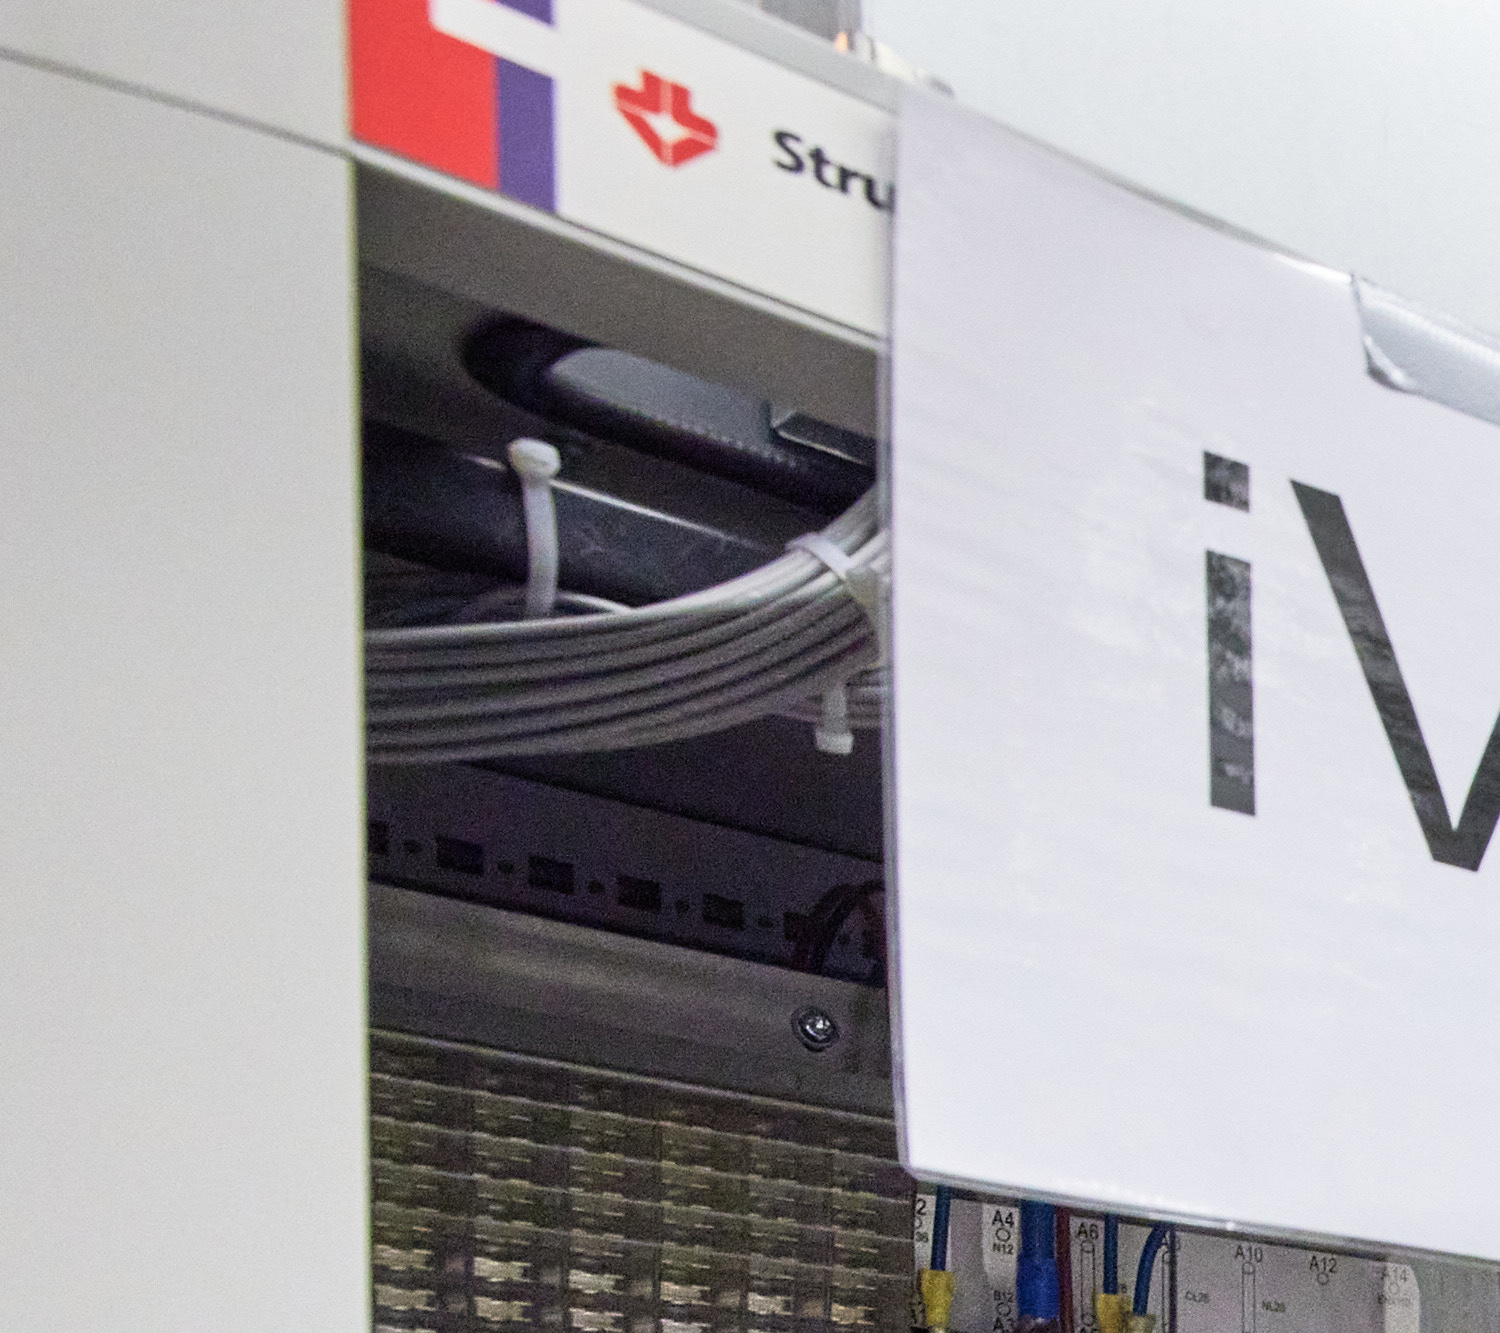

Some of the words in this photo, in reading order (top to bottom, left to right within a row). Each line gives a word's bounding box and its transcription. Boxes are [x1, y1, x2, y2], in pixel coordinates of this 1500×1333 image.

[913, 1199, 927, 1215] 2
[991, 1210, 1016, 1228] A4
[1076, 1222, 1099, 1240] A6
[1234, 1245, 1263, 1263] A10
[1309, 1256, 1337, 1274] A12
